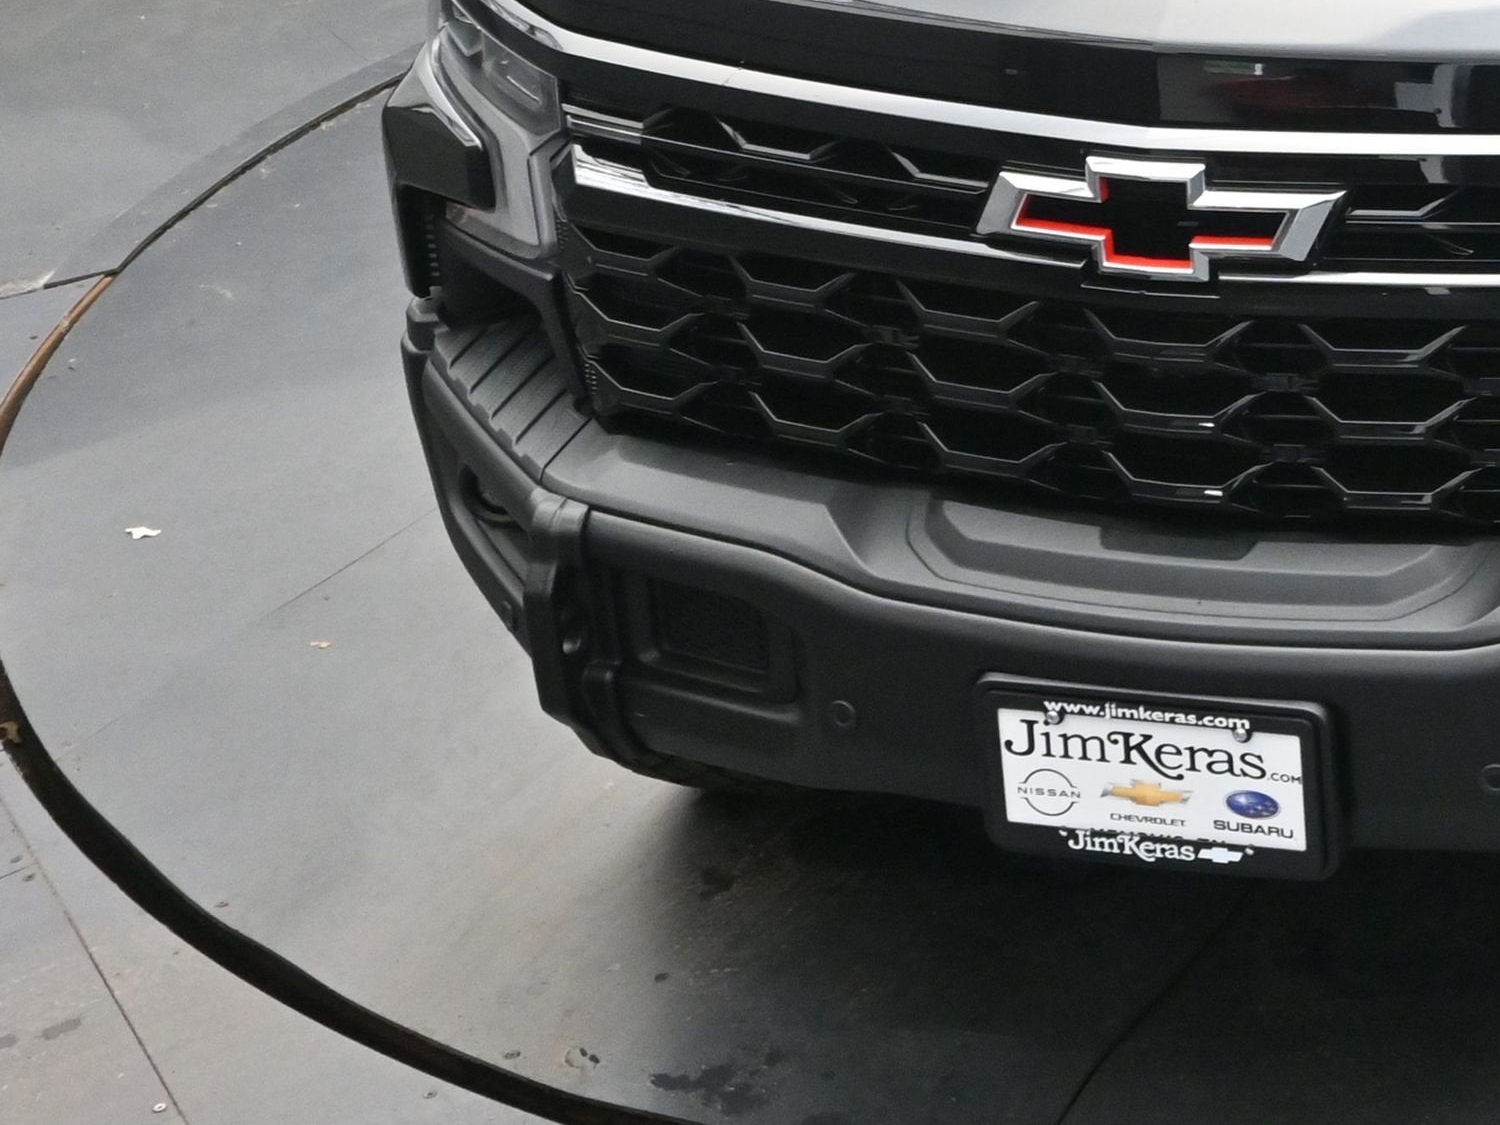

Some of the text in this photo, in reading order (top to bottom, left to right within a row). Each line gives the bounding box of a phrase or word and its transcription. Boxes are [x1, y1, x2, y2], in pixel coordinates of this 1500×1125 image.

[1043, 700, 1251, 730] www.jimkeras.com
[1017, 786, 1081, 799] NISSAN
[1109, 812, 1187, 827] CHEVROLET
[1213, 820, 1294, 839] SUBARU
